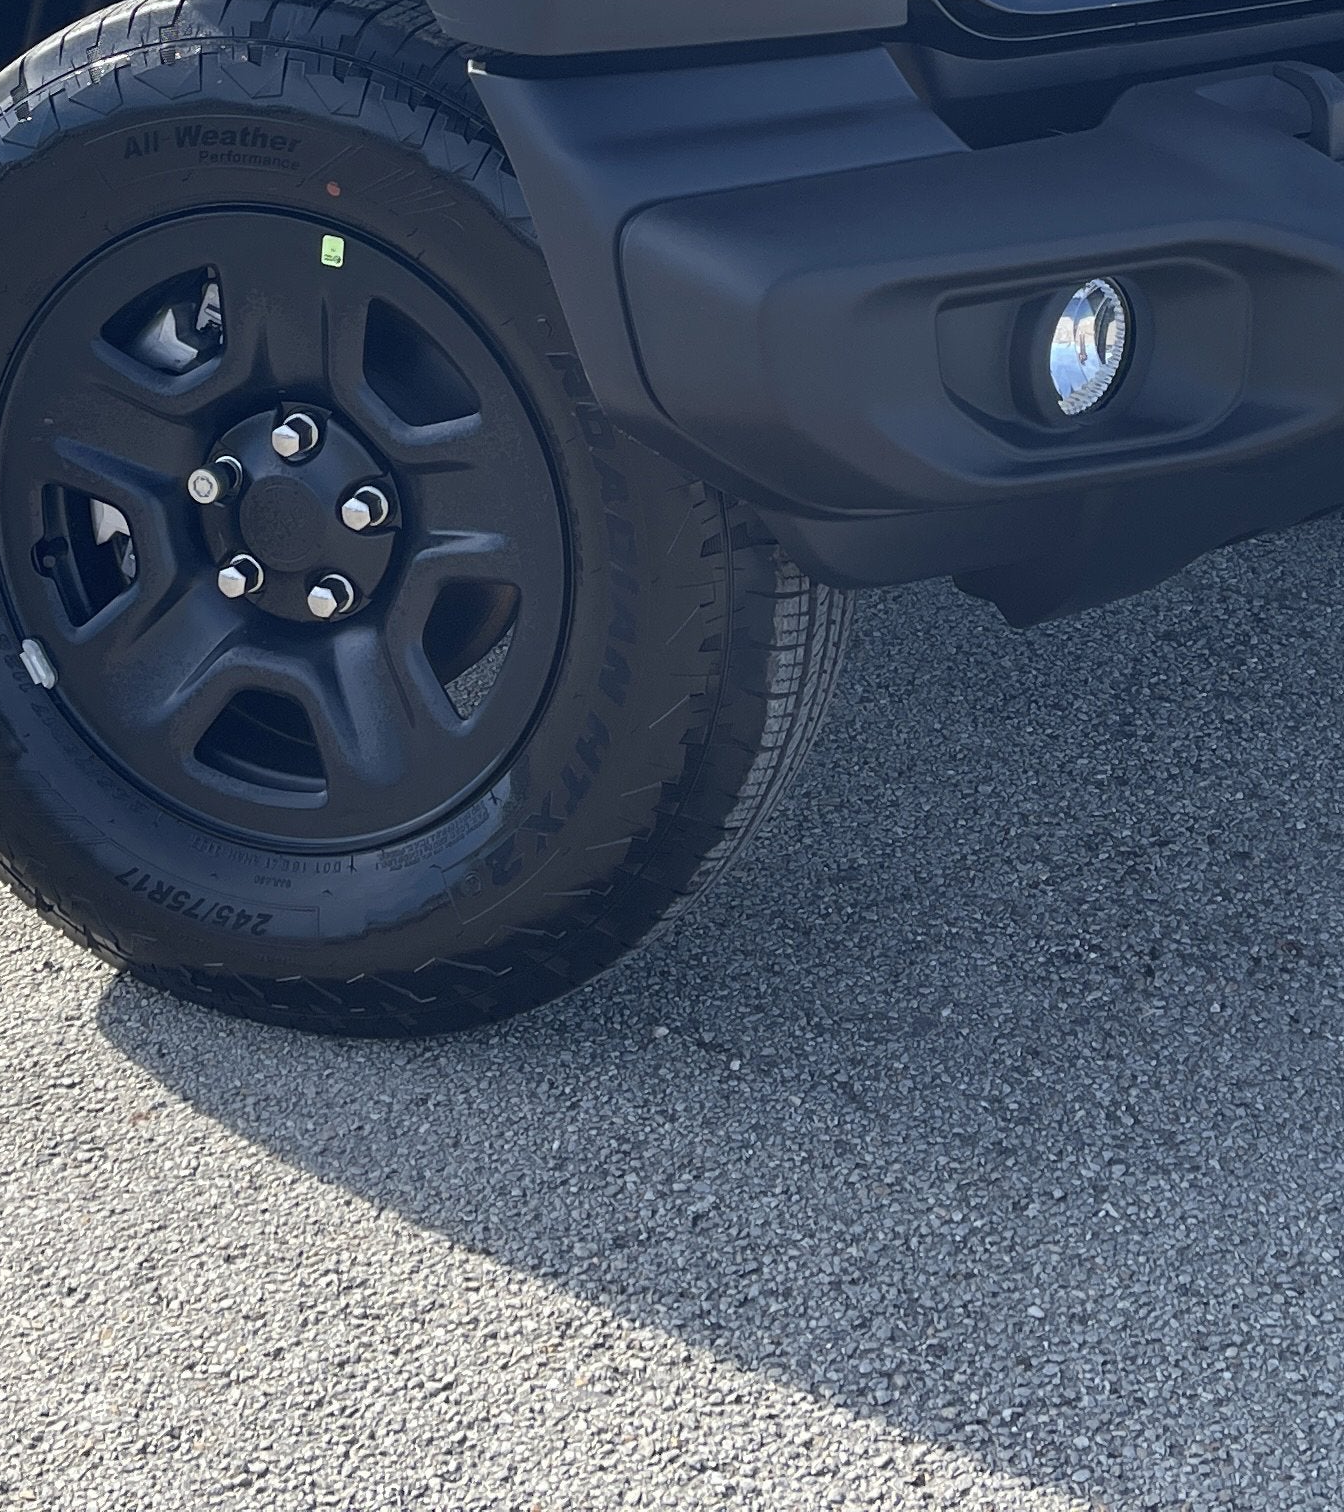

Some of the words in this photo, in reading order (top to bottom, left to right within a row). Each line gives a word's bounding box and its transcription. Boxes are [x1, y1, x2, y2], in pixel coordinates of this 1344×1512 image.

[123, 130, 159, 160] All
[174, 124, 303, 153] Weather
[198, 148, 301, 171] Performance
[114, 866, 274, 937] 245/75R17
